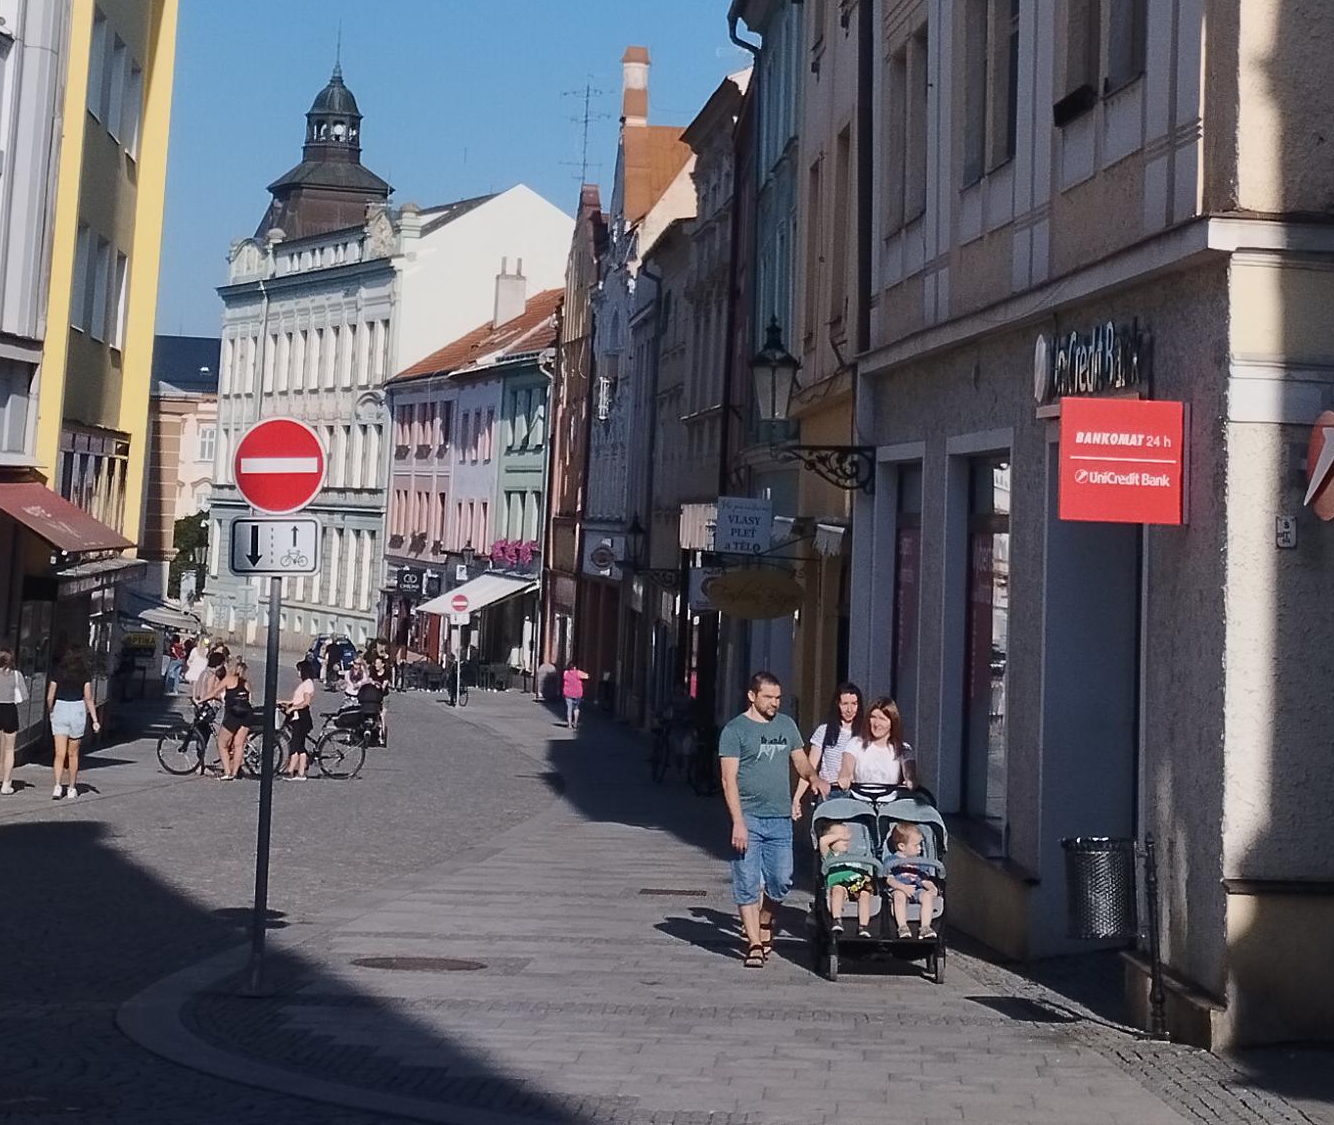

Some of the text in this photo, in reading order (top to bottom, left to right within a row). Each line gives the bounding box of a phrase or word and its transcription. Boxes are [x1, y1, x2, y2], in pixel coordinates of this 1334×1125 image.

[1075, 431, 1172, 448] BANKOMAT 24 h
[1089, 471, 1171, 487] UniCredit Bank
[728, 515, 762, 525] VLASY
